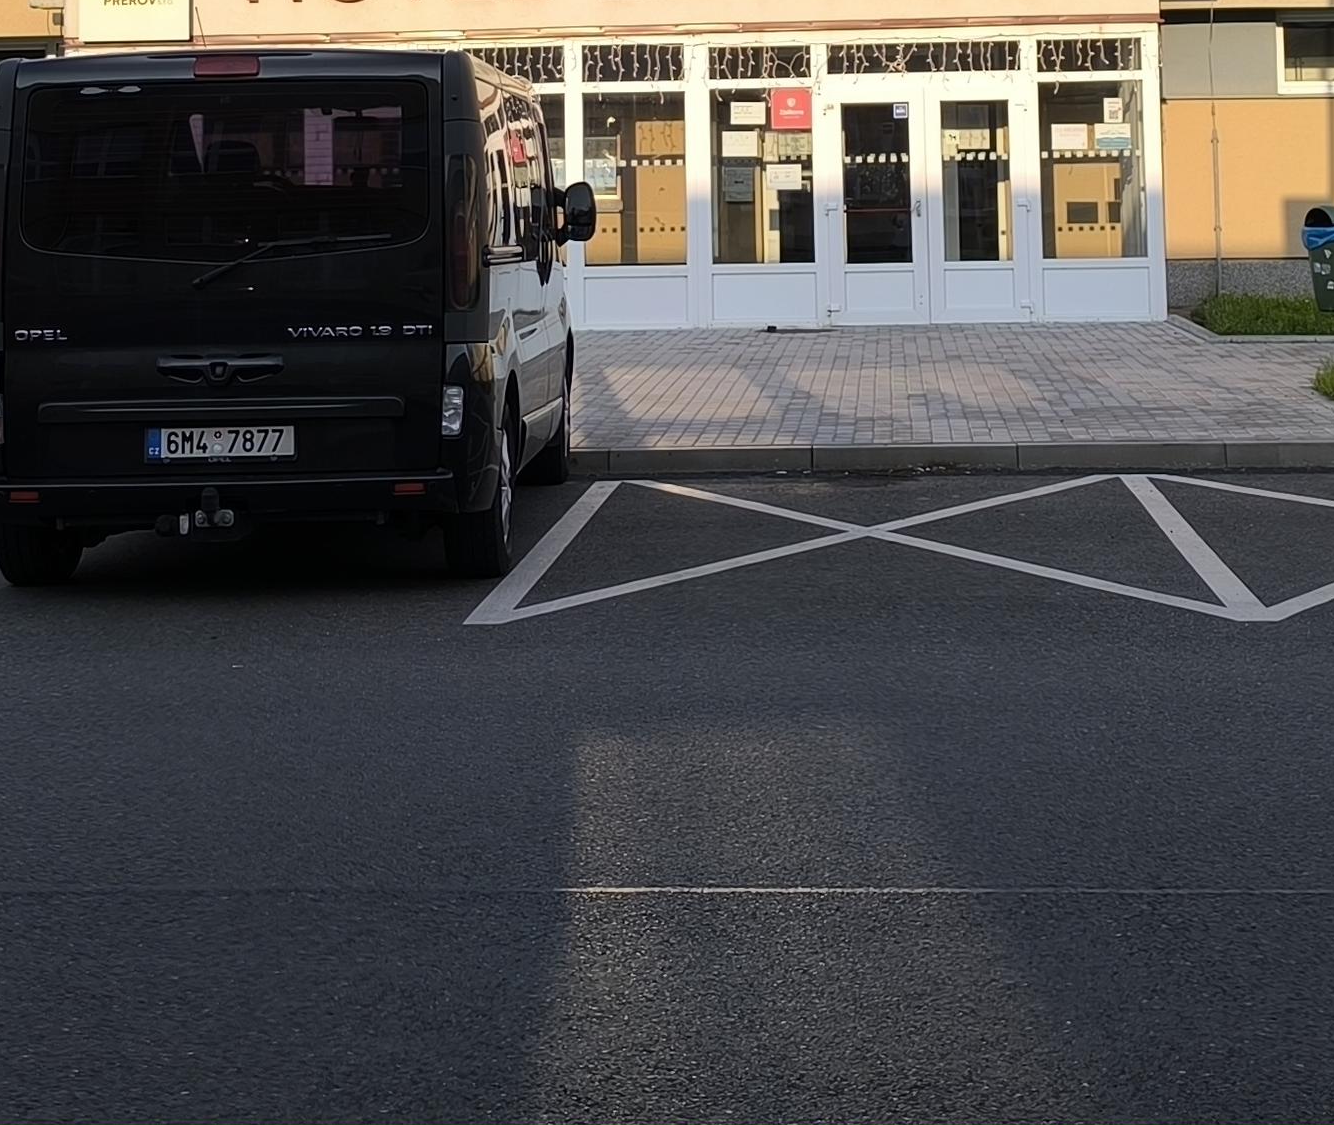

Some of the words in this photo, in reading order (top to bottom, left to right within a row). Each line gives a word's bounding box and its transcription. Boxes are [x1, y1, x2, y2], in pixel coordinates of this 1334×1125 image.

[14, 329, 67, 341] OPEL
[287, 326, 363, 338] VIVARO
[402, 325, 433, 335] DTI
[166, 430, 208, 455] 6M4
[227, 428, 285, 454] 7877
[148, 447, 160, 455] CZ
